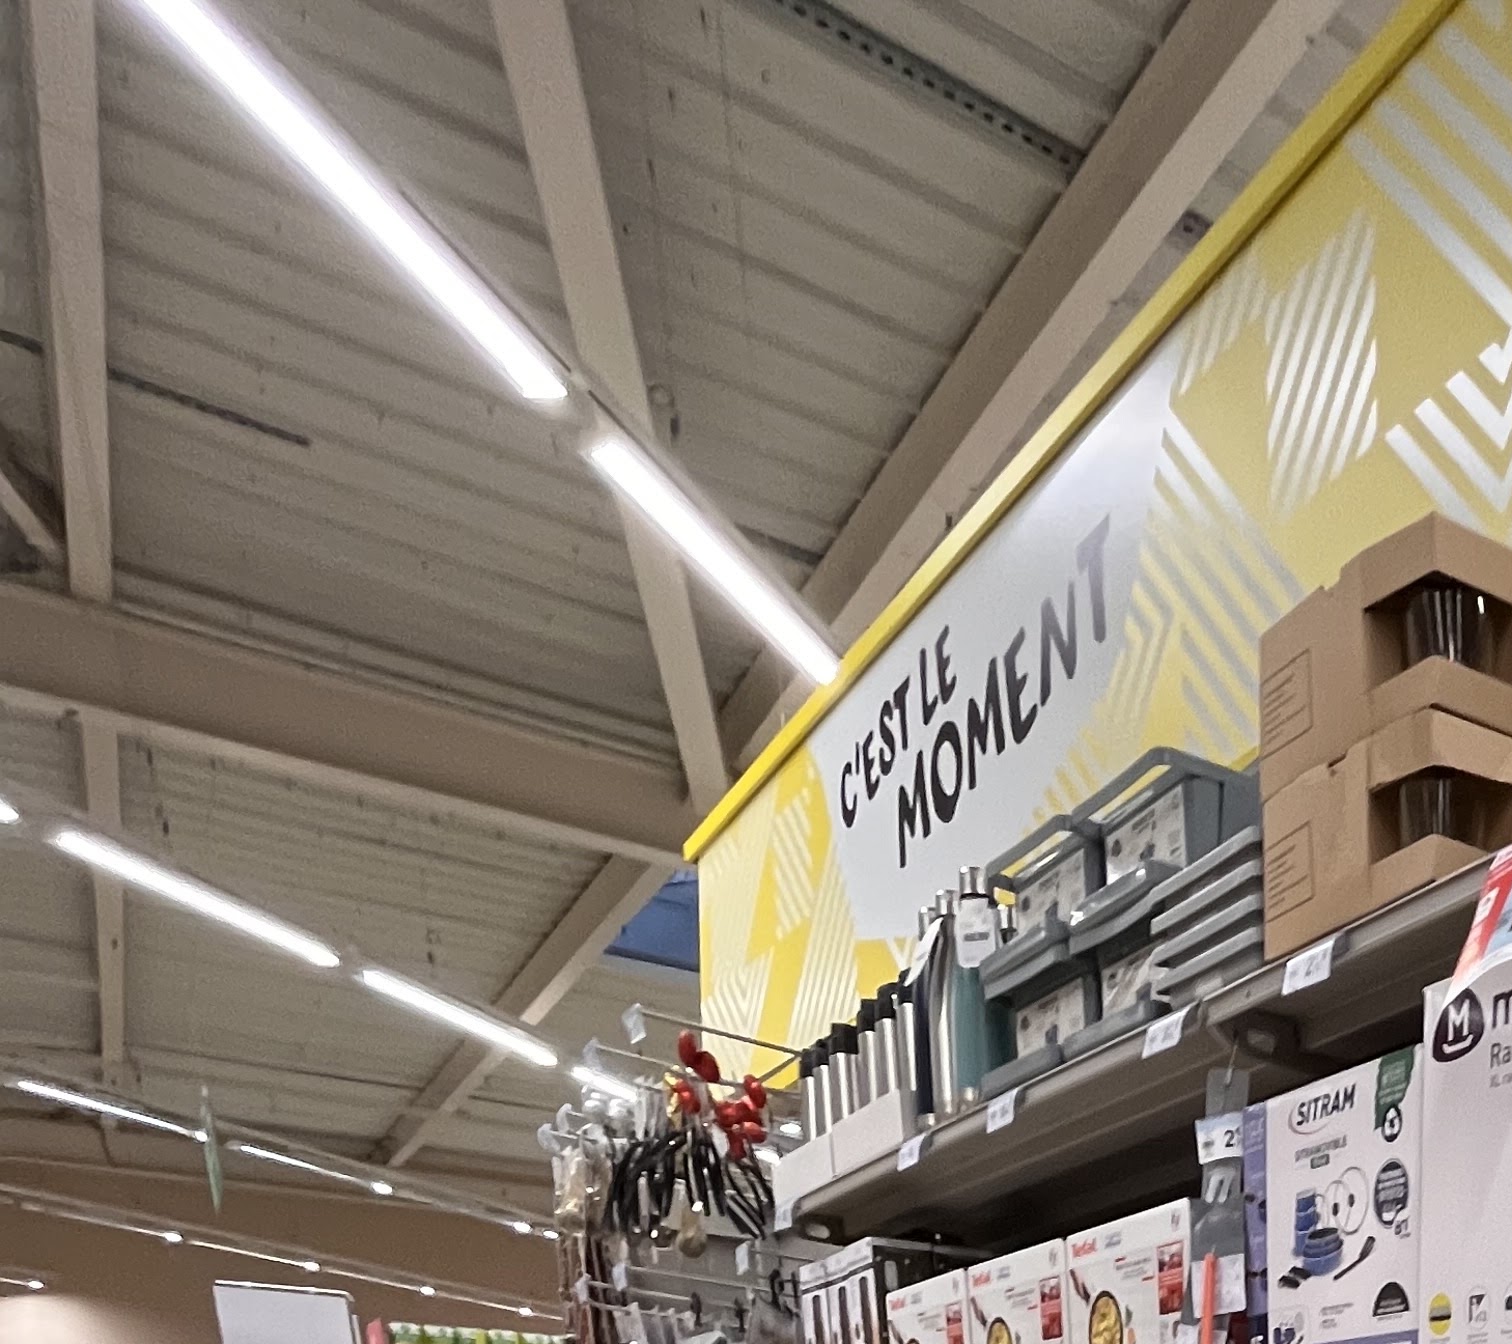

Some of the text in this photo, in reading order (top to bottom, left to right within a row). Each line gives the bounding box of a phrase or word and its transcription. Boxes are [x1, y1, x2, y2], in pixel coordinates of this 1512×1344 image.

[839, 624, 958, 828] C'EST LE
[895, 512, 1111, 869] MOMENT
[1296, 1083, 1356, 1126] SITRAM
